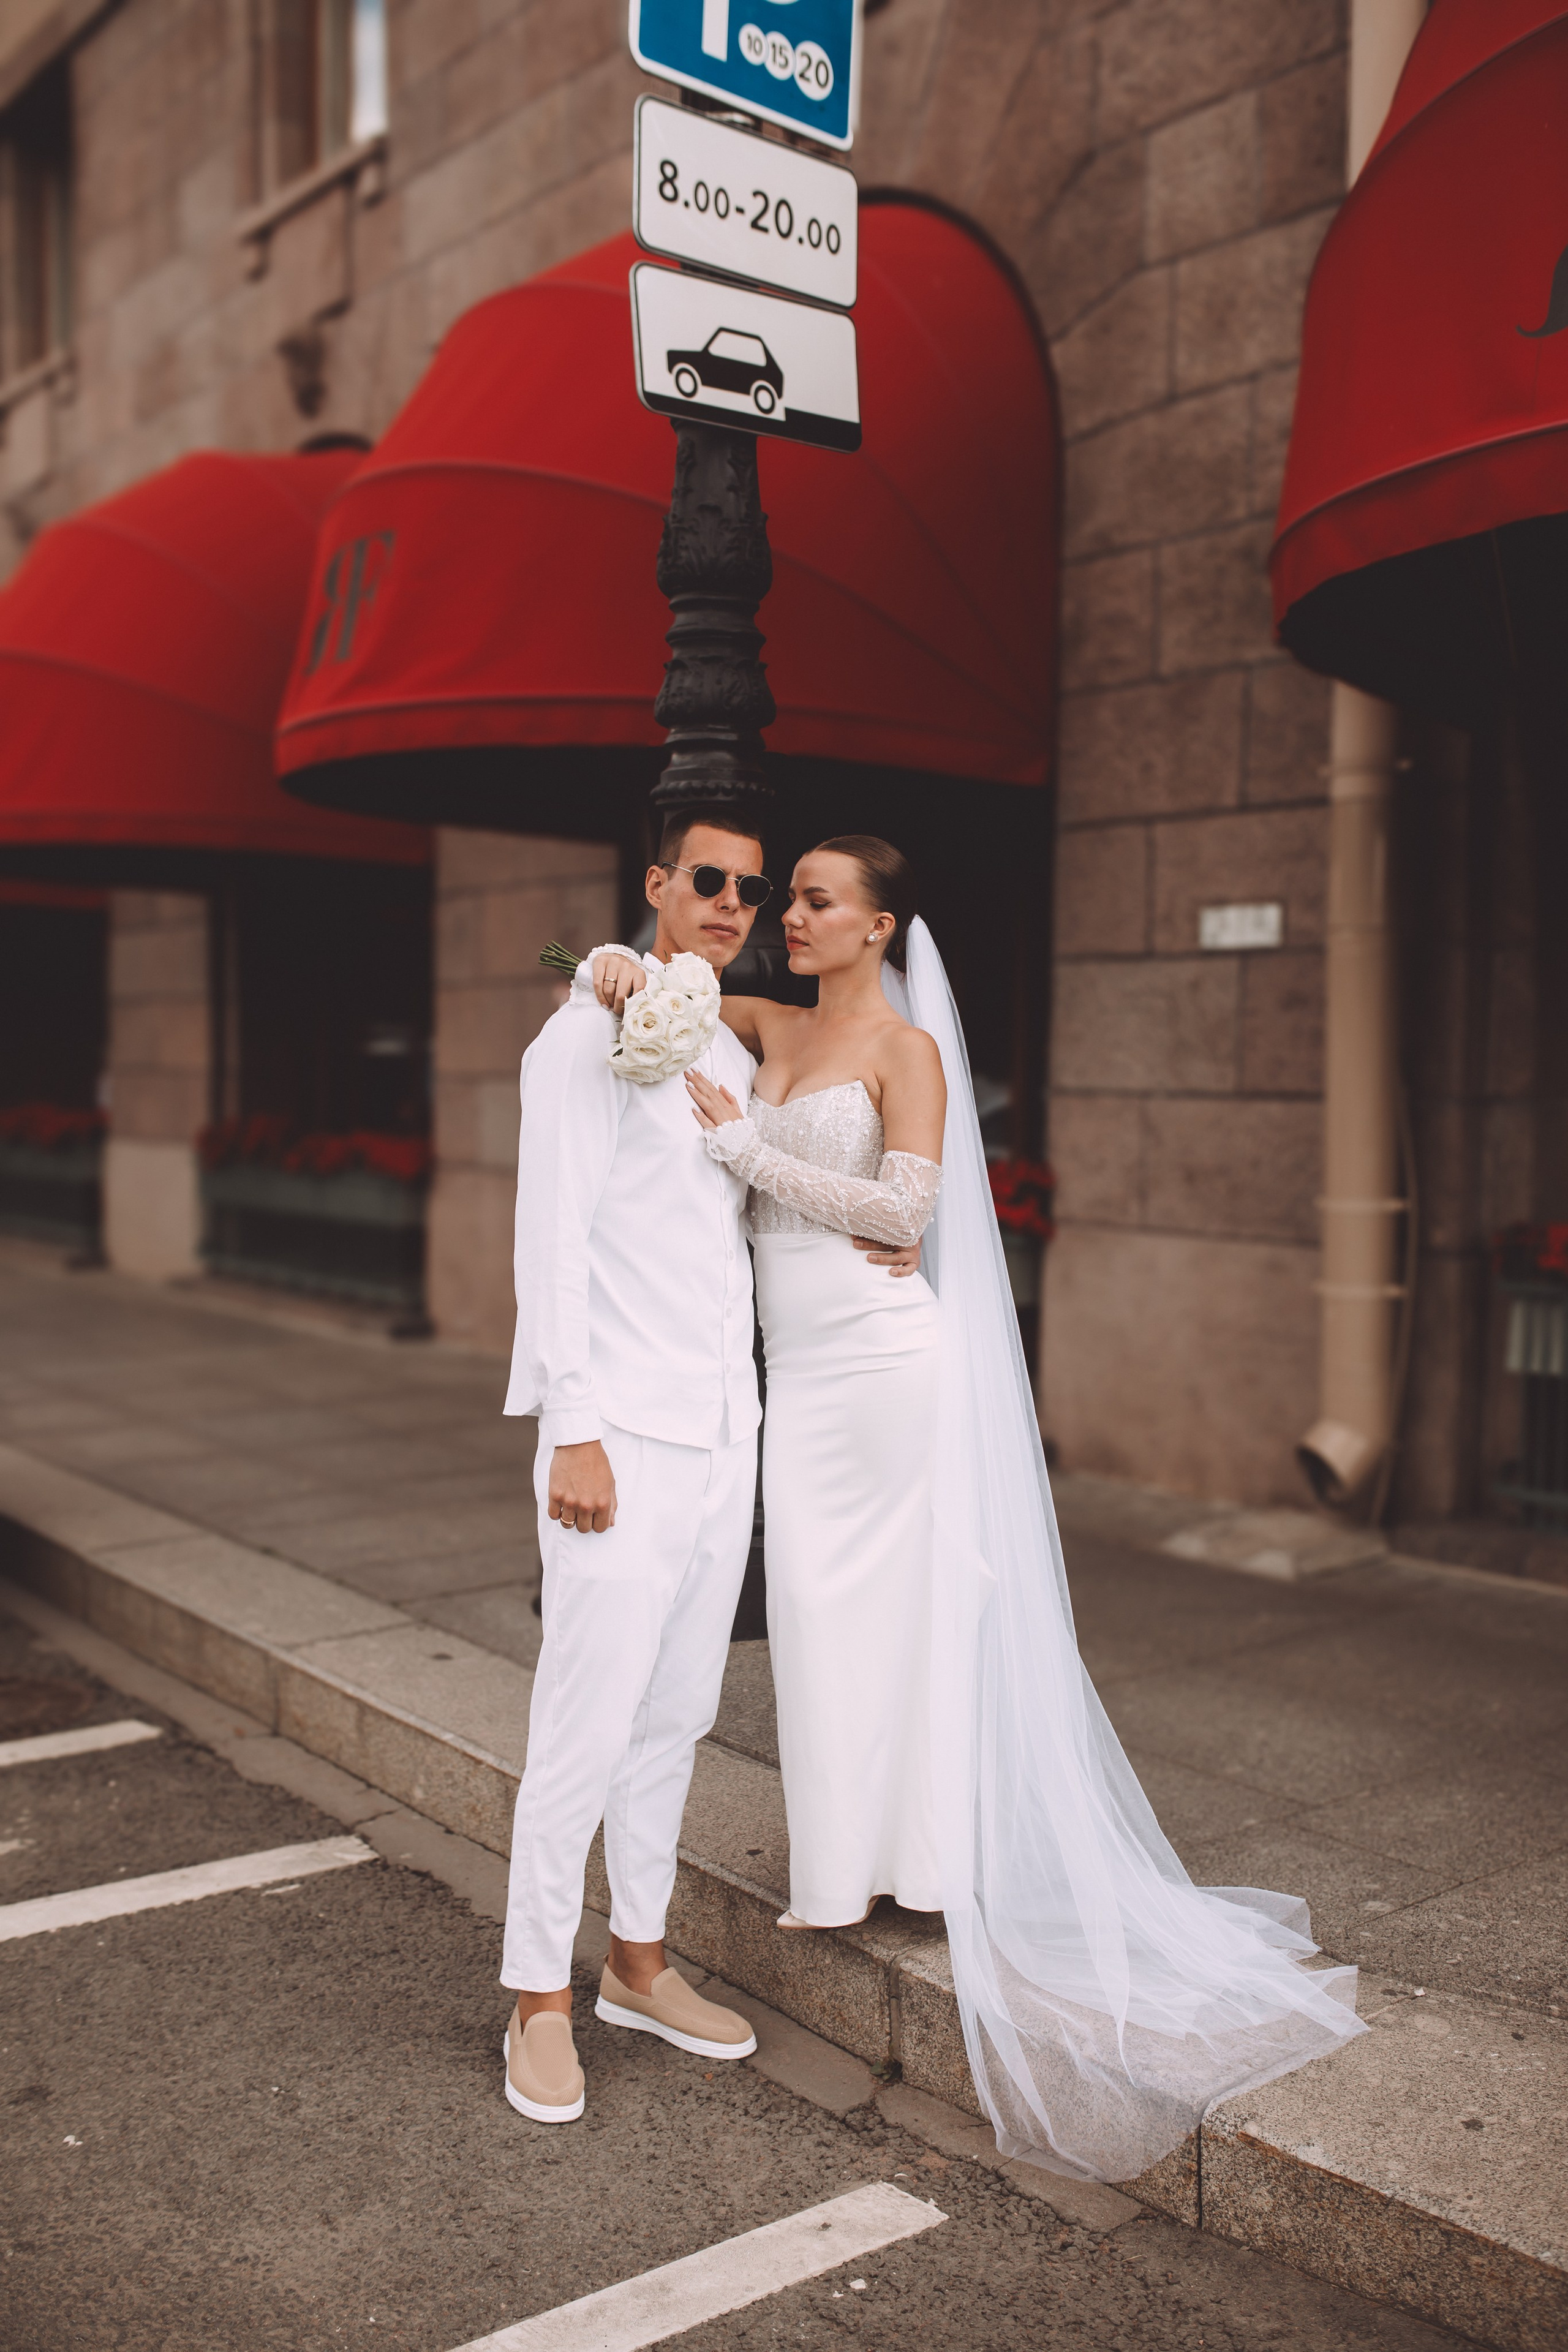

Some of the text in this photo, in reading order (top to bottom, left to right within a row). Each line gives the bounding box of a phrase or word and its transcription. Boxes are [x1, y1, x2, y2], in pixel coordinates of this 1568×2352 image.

[747, 33, 829, 88] 10 15 20
[658, 159, 840, 254] 8.00-20.00
